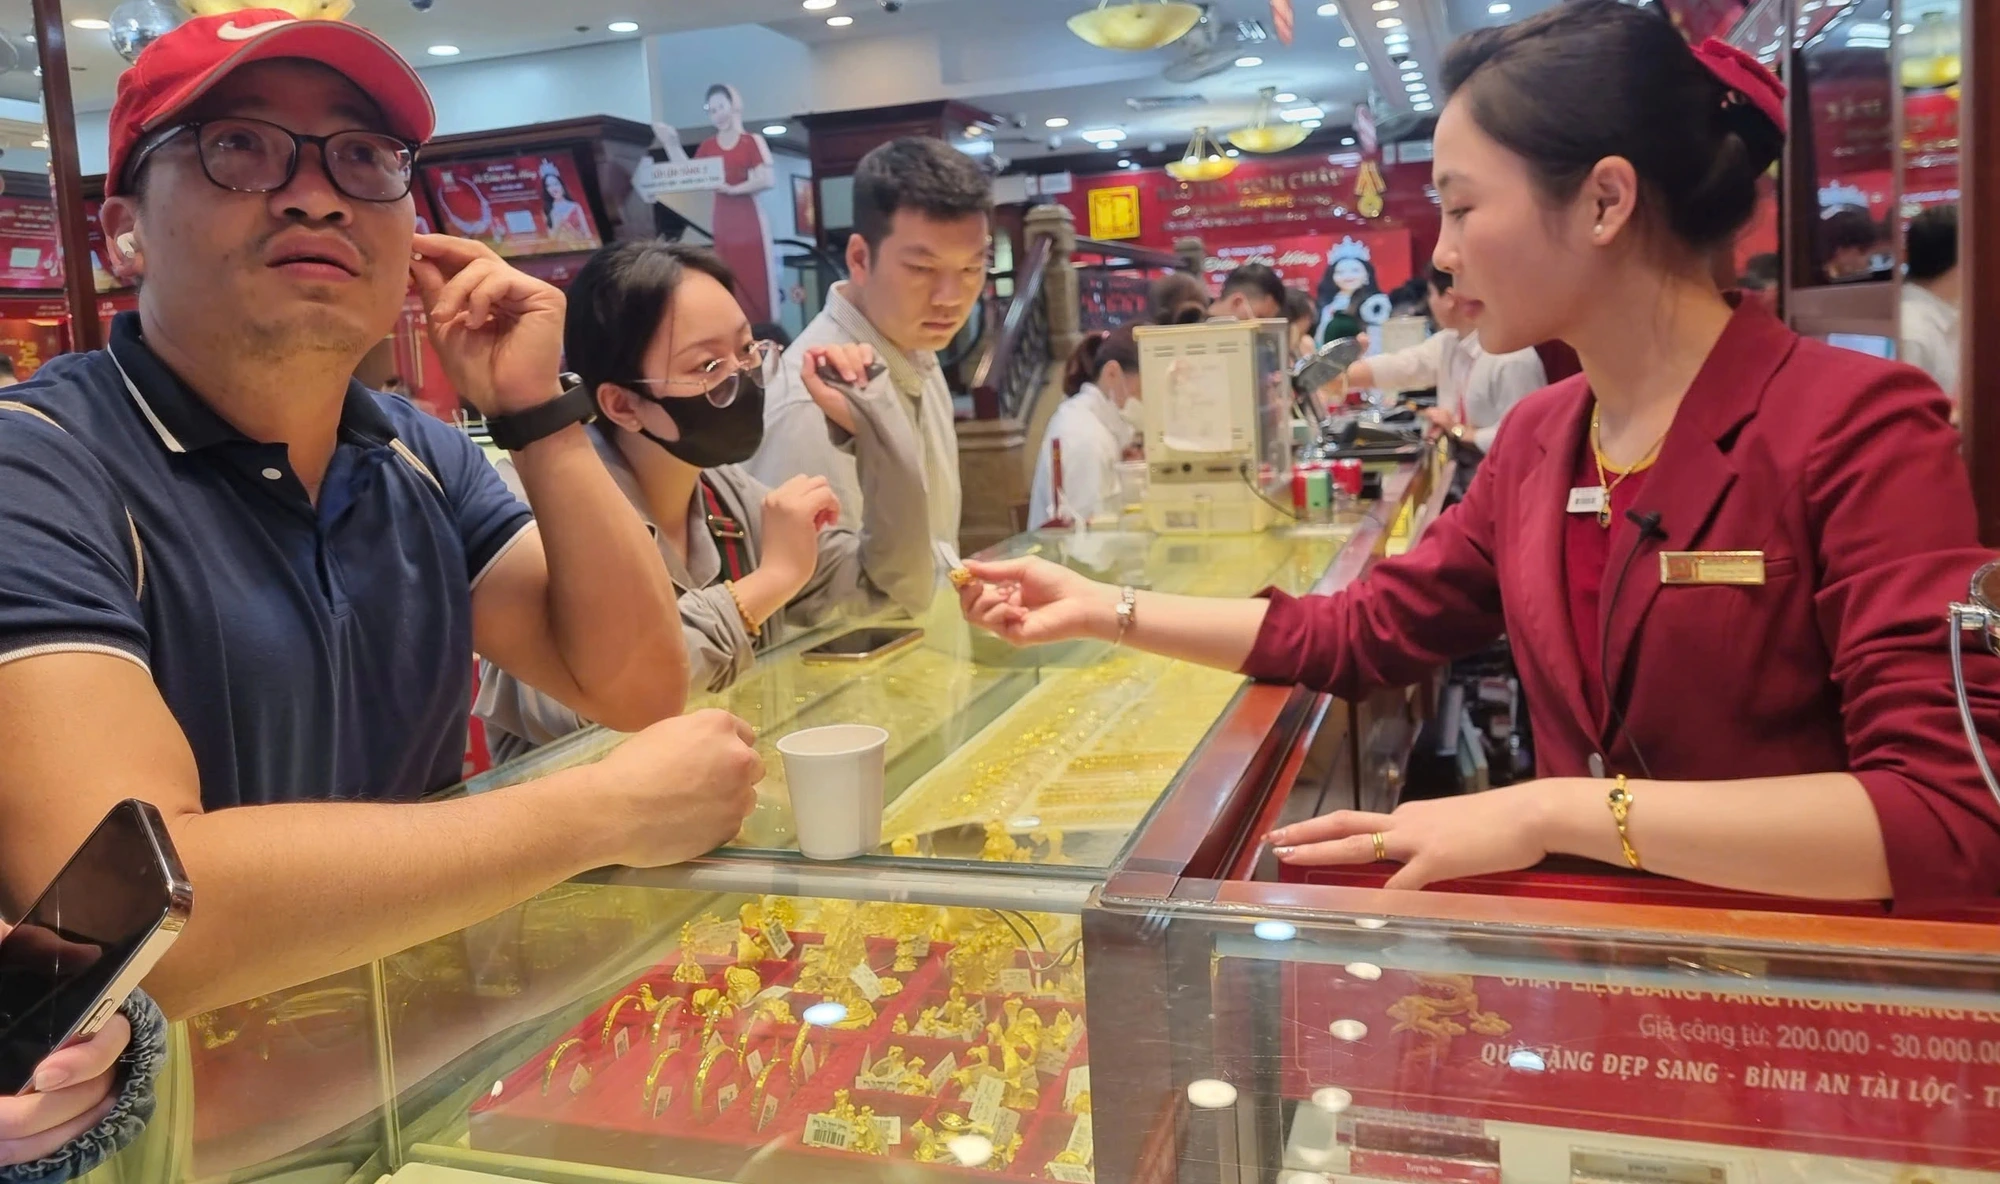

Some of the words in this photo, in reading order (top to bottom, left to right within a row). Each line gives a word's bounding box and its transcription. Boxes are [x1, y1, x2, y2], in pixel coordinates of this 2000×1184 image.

[1638, 1013, 1678, 1041] Giá
[1680, 1018, 1734, 1048] công
[1777, 1025, 1869, 1055] 200.000
[1603, 1052, 1649, 1081] ĐẸP
[1655, 1058, 1720, 1084] SANG
[1744, 1061, 1807, 1092] BÌNH
[1815, 1073, 1850, 1096] AN
[1860, 1071, 1899, 1101] TÀI
[1908, 1075, 1957, 1109] LỘC
